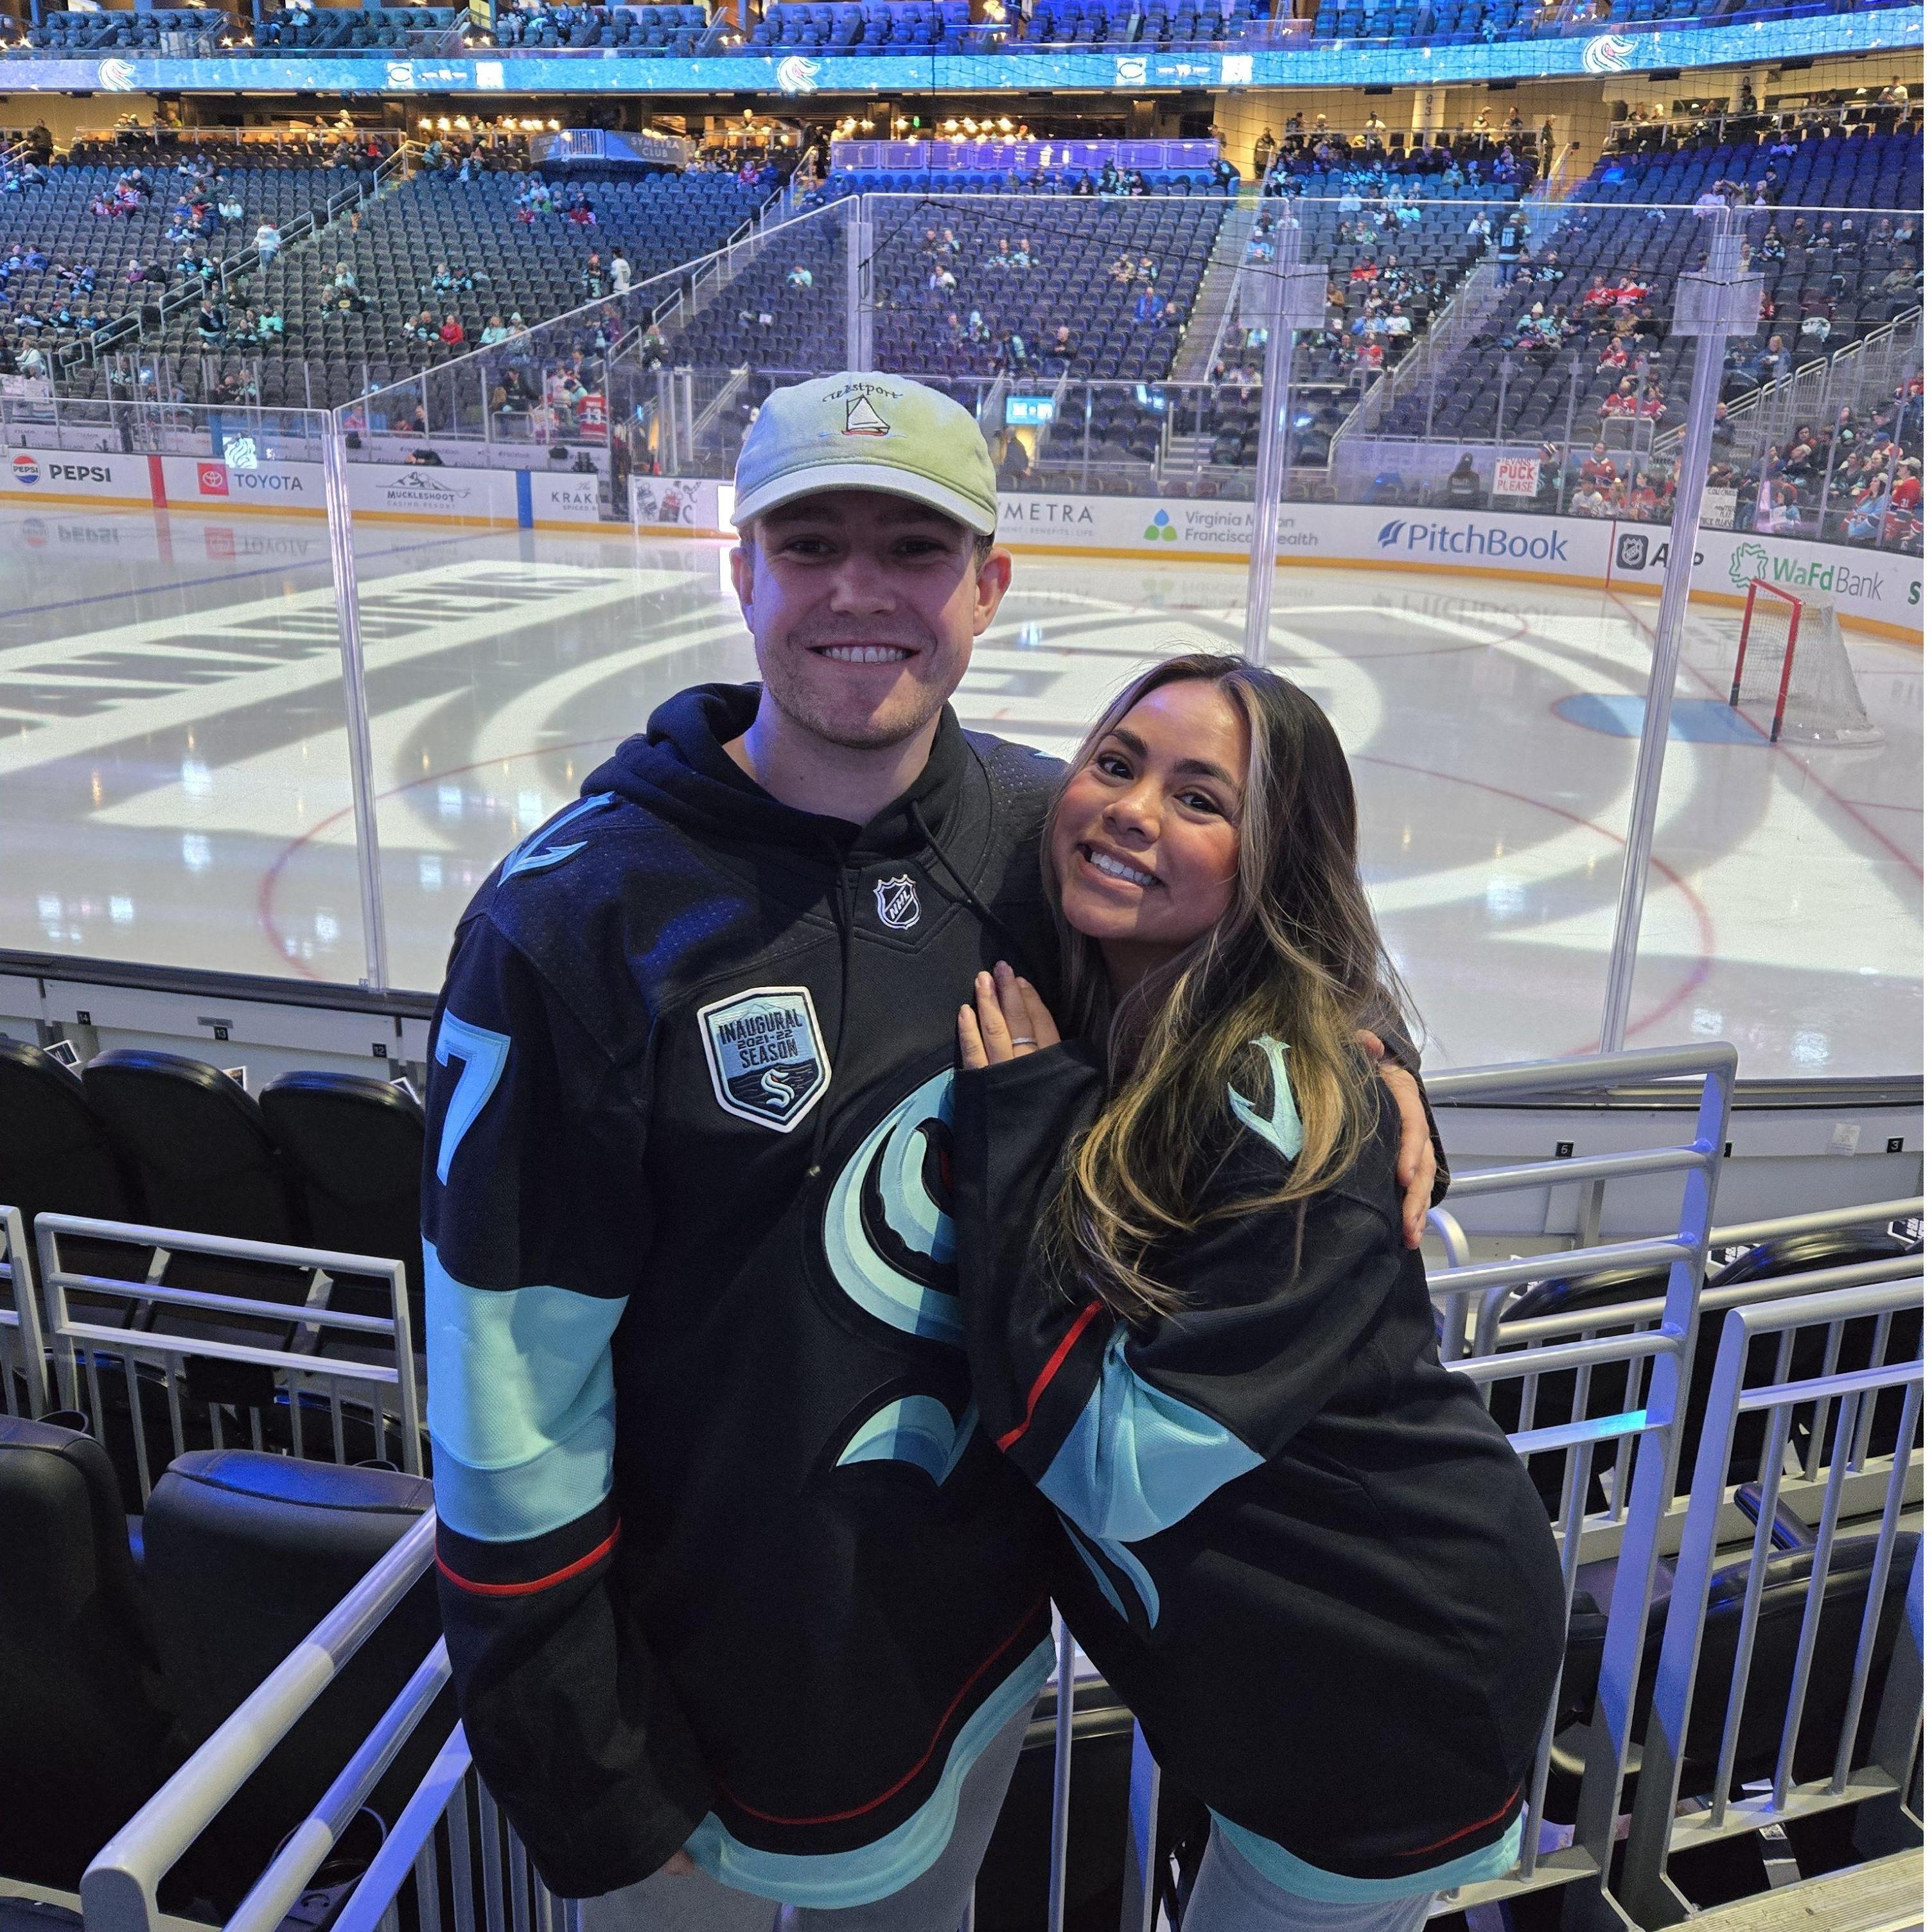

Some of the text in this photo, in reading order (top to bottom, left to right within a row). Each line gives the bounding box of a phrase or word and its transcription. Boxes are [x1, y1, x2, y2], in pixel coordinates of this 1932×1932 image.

[631, 136, 680, 150] SYMETRA
[642, 148, 668, 158] CLUB
[49, 464, 111, 482] PEPSI
[1499, 465, 1535, 480] PUCK
[234, 474, 303, 491] TOYOTA
[1497, 479, 1533, 493] PLEASE
[387, 491, 455, 502] MUCKLESHOOT
[999, 503, 1093, 523] METRA
[1186, 511, 1242, 529] Virginia
[1277, 533, 1318, 546] ealth
[1407, 523, 1568, 561] PitchBook
[889, 890, 911, 920] NHL
[217, 1028, 226, 1039] 13
[719, 1008, 802, 1045] INAUGURAL
[737, 1028, 793, 1049] 2021-22
[374, 1046, 385, 1055] 12
[739, 1038, 798, 1068] SEASON
[435, 1006, 511, 1186] 7
[1891, 1141, 1899, 1150] 3
